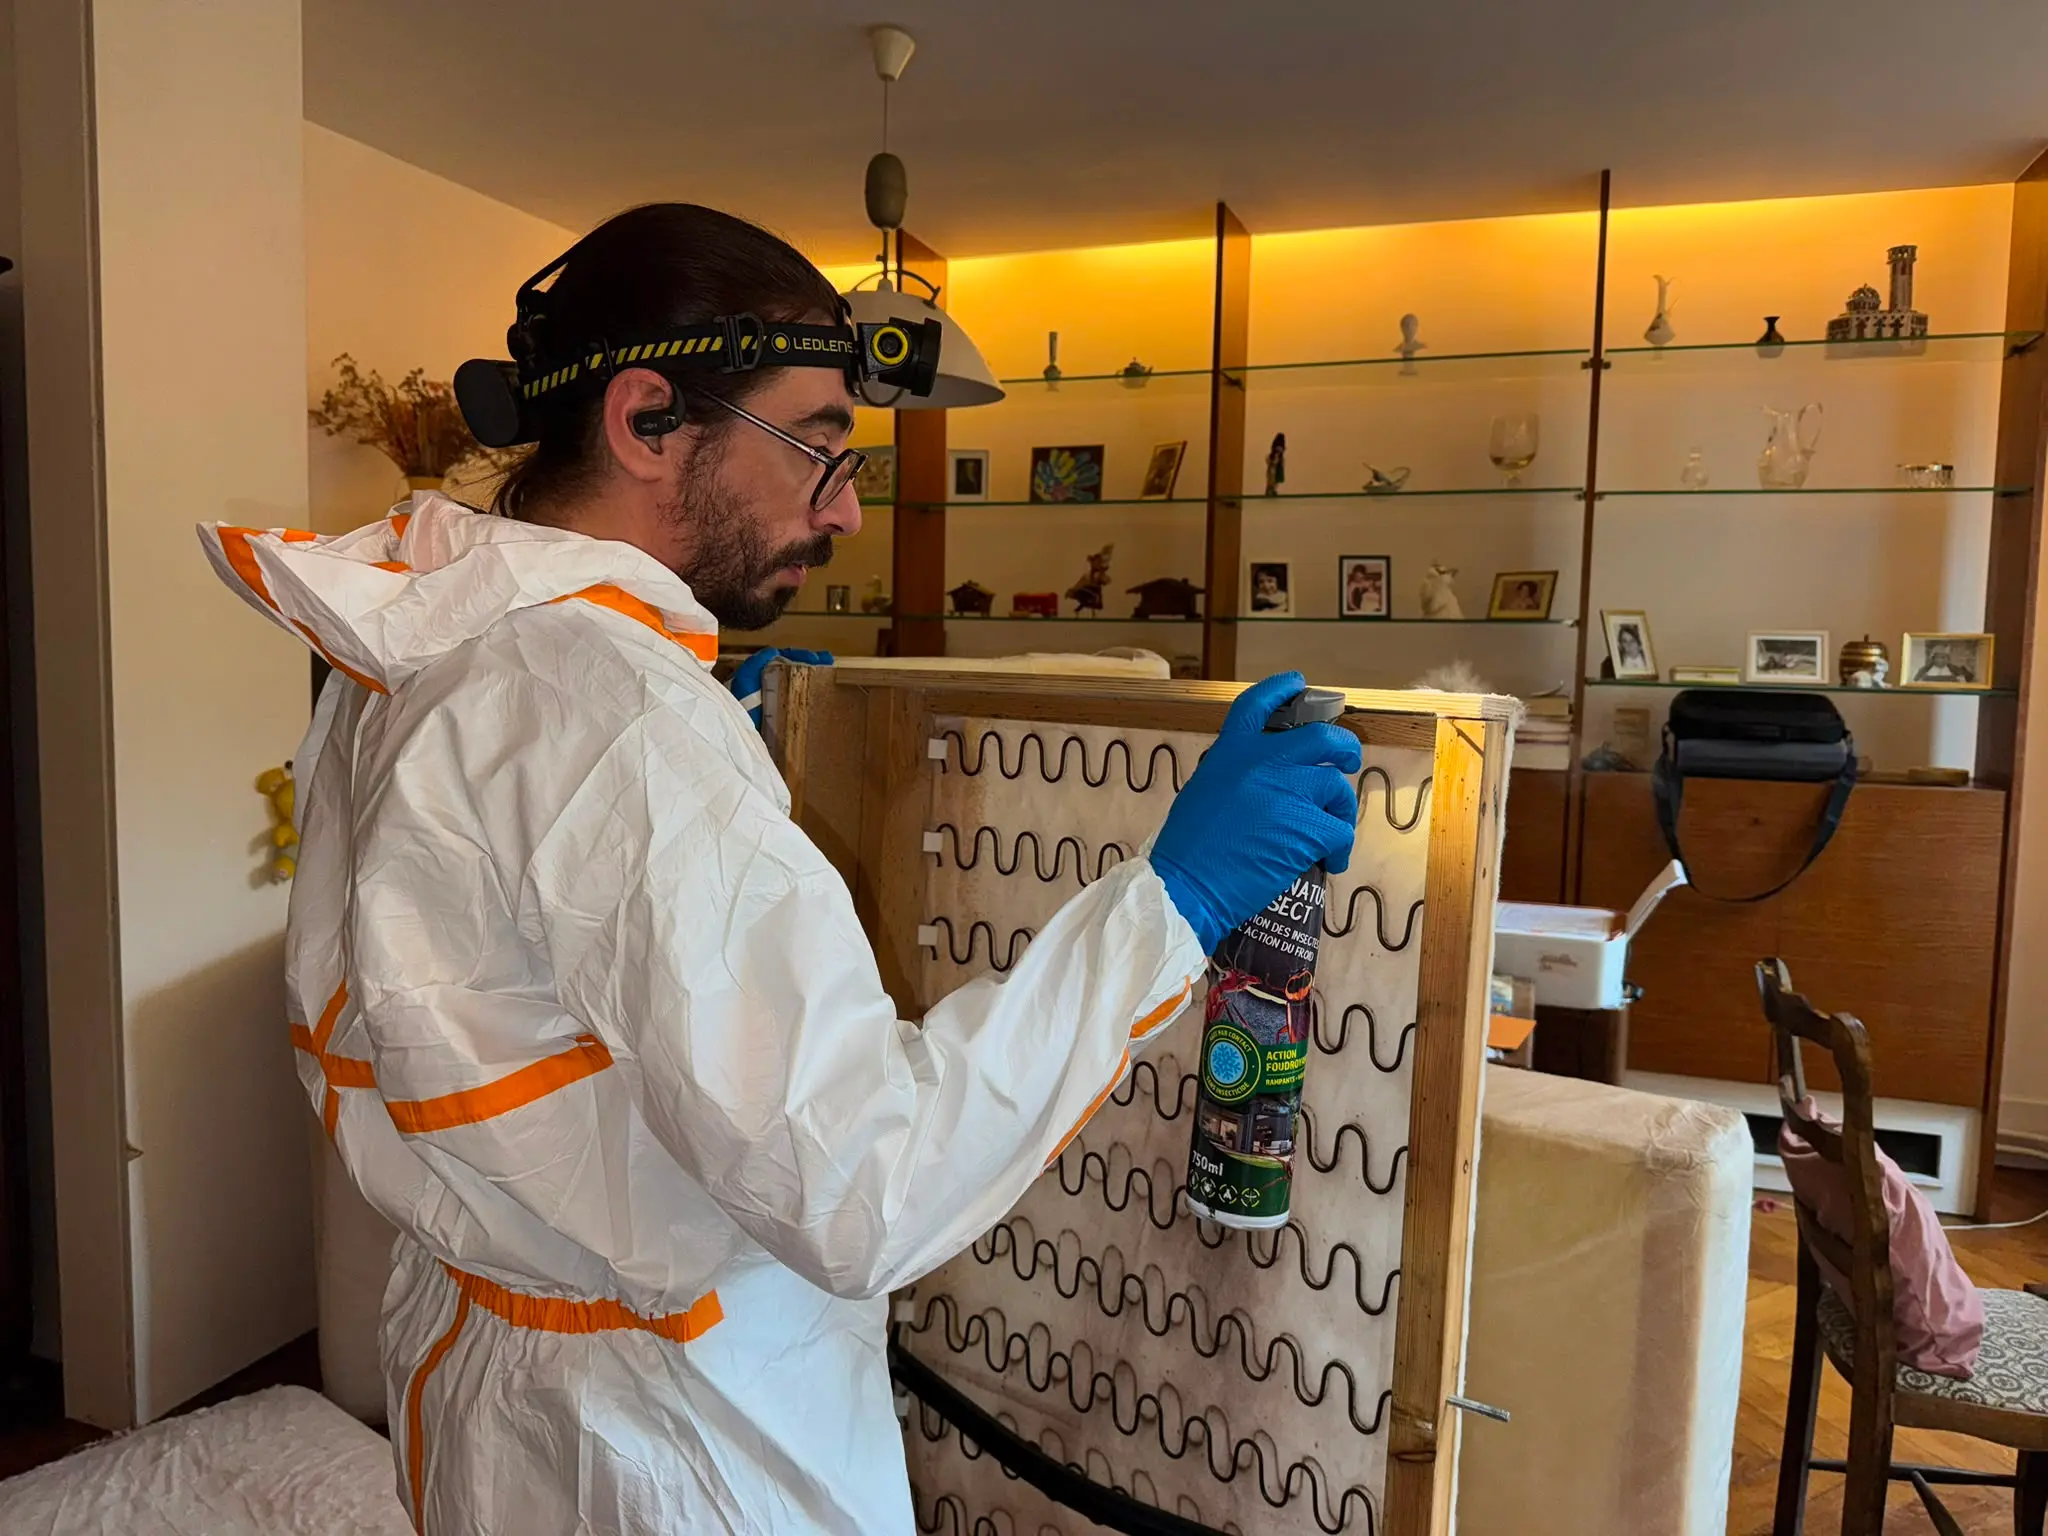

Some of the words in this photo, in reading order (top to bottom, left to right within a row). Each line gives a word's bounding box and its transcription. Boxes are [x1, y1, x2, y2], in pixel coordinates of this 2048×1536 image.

[1271, 922, 1291, 938] DES
[1281, 941, 1295, 954] DU
[1295, 946, 1315, 962] FROID
[1228, 1031, 1252, 1053] CONTACT
[1266, 1049, 1297, 1060] ACTION
[1216, 1082, 1250, 1096] INSECTICIDE
[1192, 1149, 1224, 1176] 750ml
